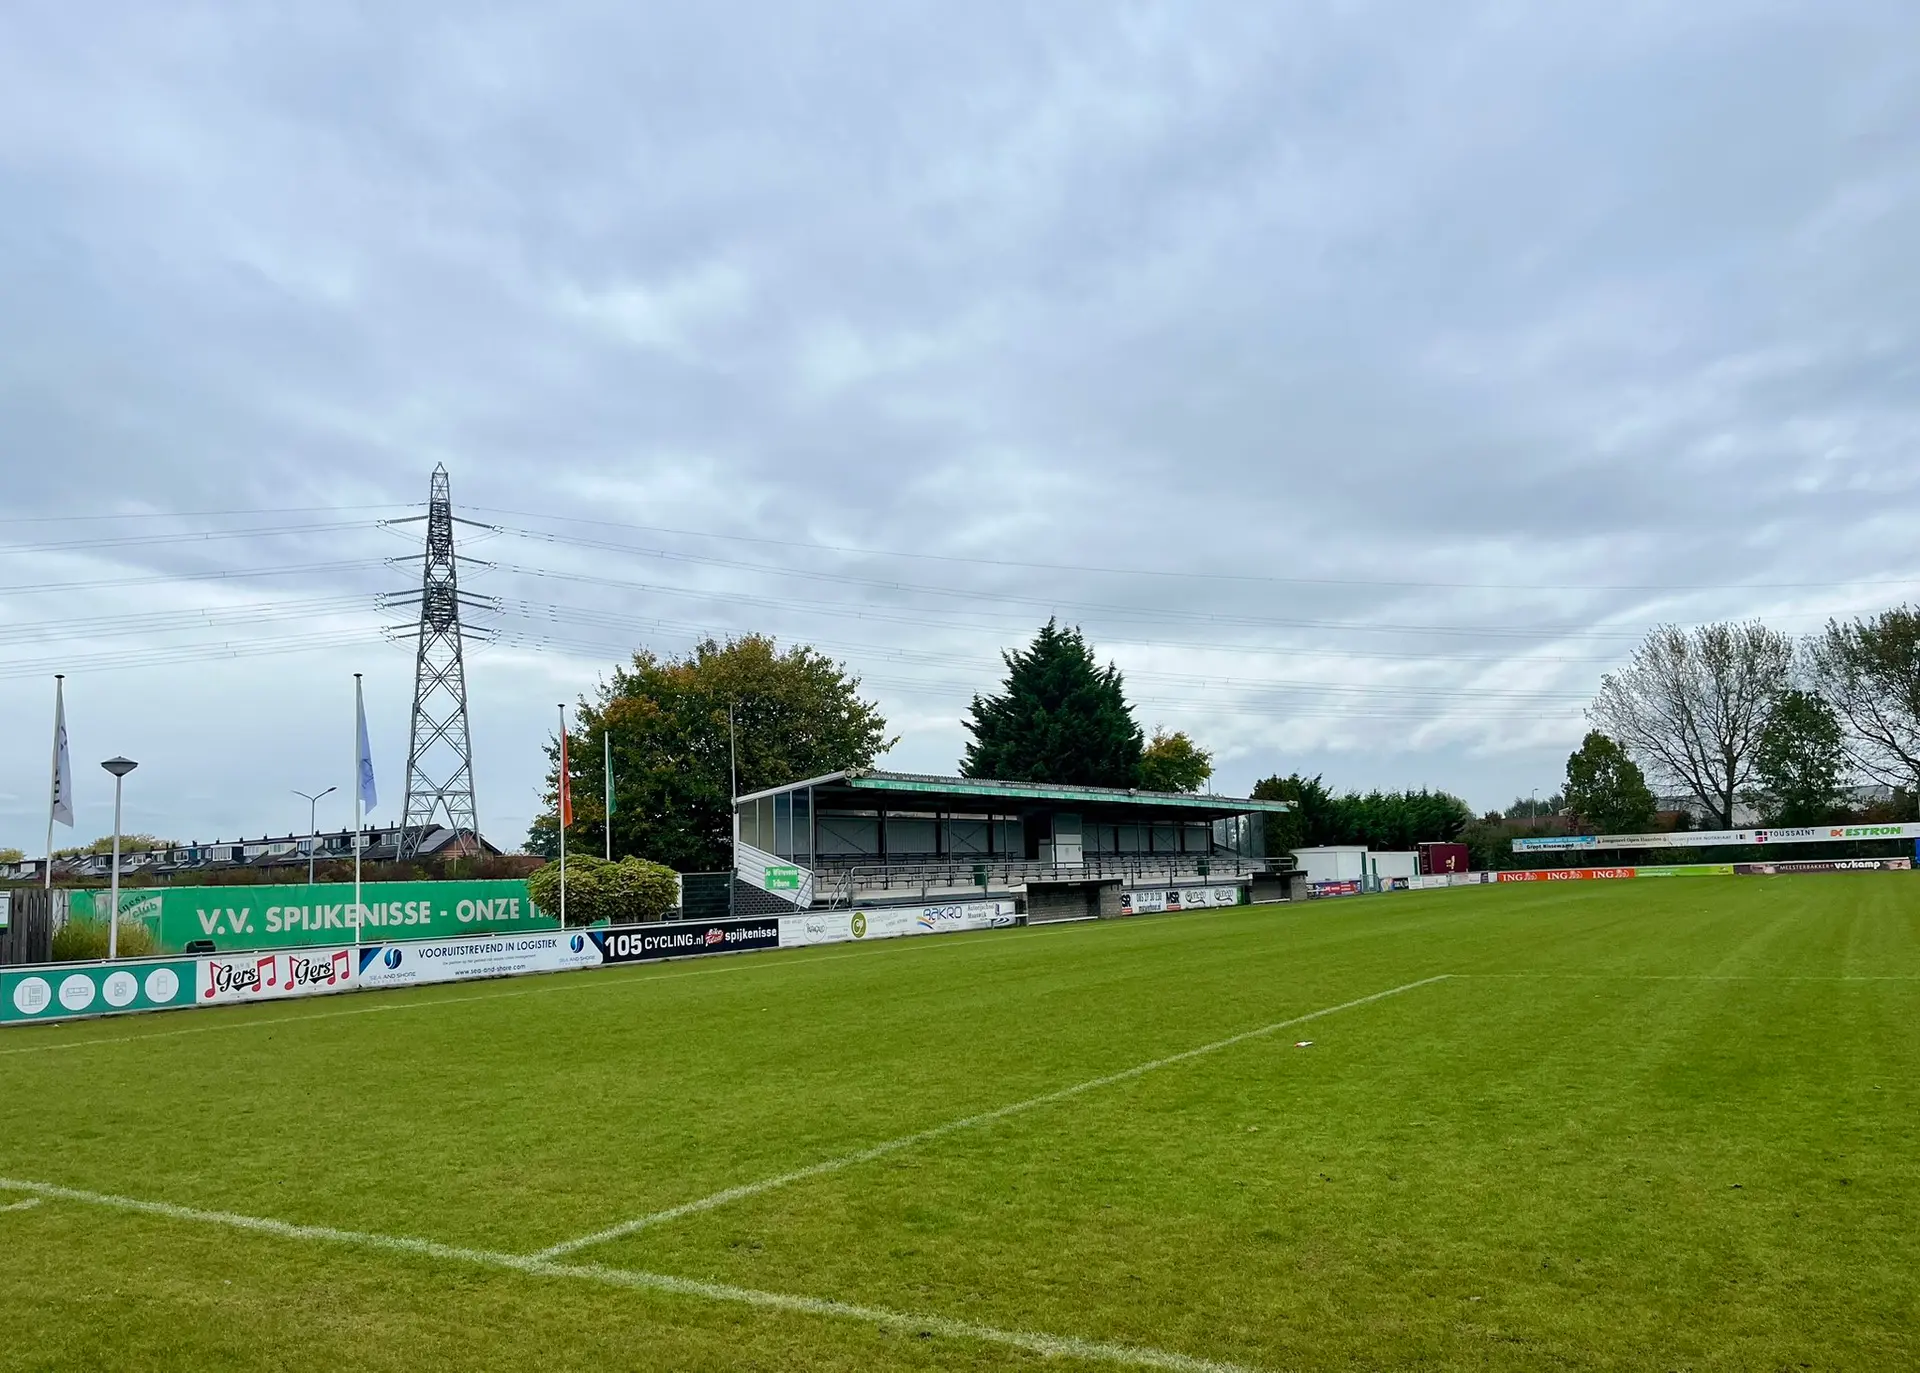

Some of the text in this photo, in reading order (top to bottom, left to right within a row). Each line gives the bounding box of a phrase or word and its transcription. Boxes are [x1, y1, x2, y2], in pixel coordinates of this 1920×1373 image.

[1769, 829, 1815, 837] TOUSSAINT
[1834, 860, 1880, 870] voskamp
[1502, 873, 1522, 882] ING
[1547, 871, 1568, 880] ING
[1592, 870, 1613, 879] ING
[1121, 894, 1132, 908] SR
[1165, 891, 1180, 904] MSR
[196, 907, 254, 935] V.V.
[265, 901, 431, 934] SPIJKENISSE
[456, 898, 520, 924] ONZE
[724, 927, 778, 943] spijkenisse
[418, 942, 503, 959] VOORUITSTREVEND
[505, 941, 516, 952] IN
[516, 938, 558, 952] LOGISTIEK
[605, 934, 704, 957] 105 CYCLING.nl
[295, 958, 333, 986] Gers
[454, 963, 526, 976] www.sea-and-shore.com
[216, 964, 258, 993] Gers
